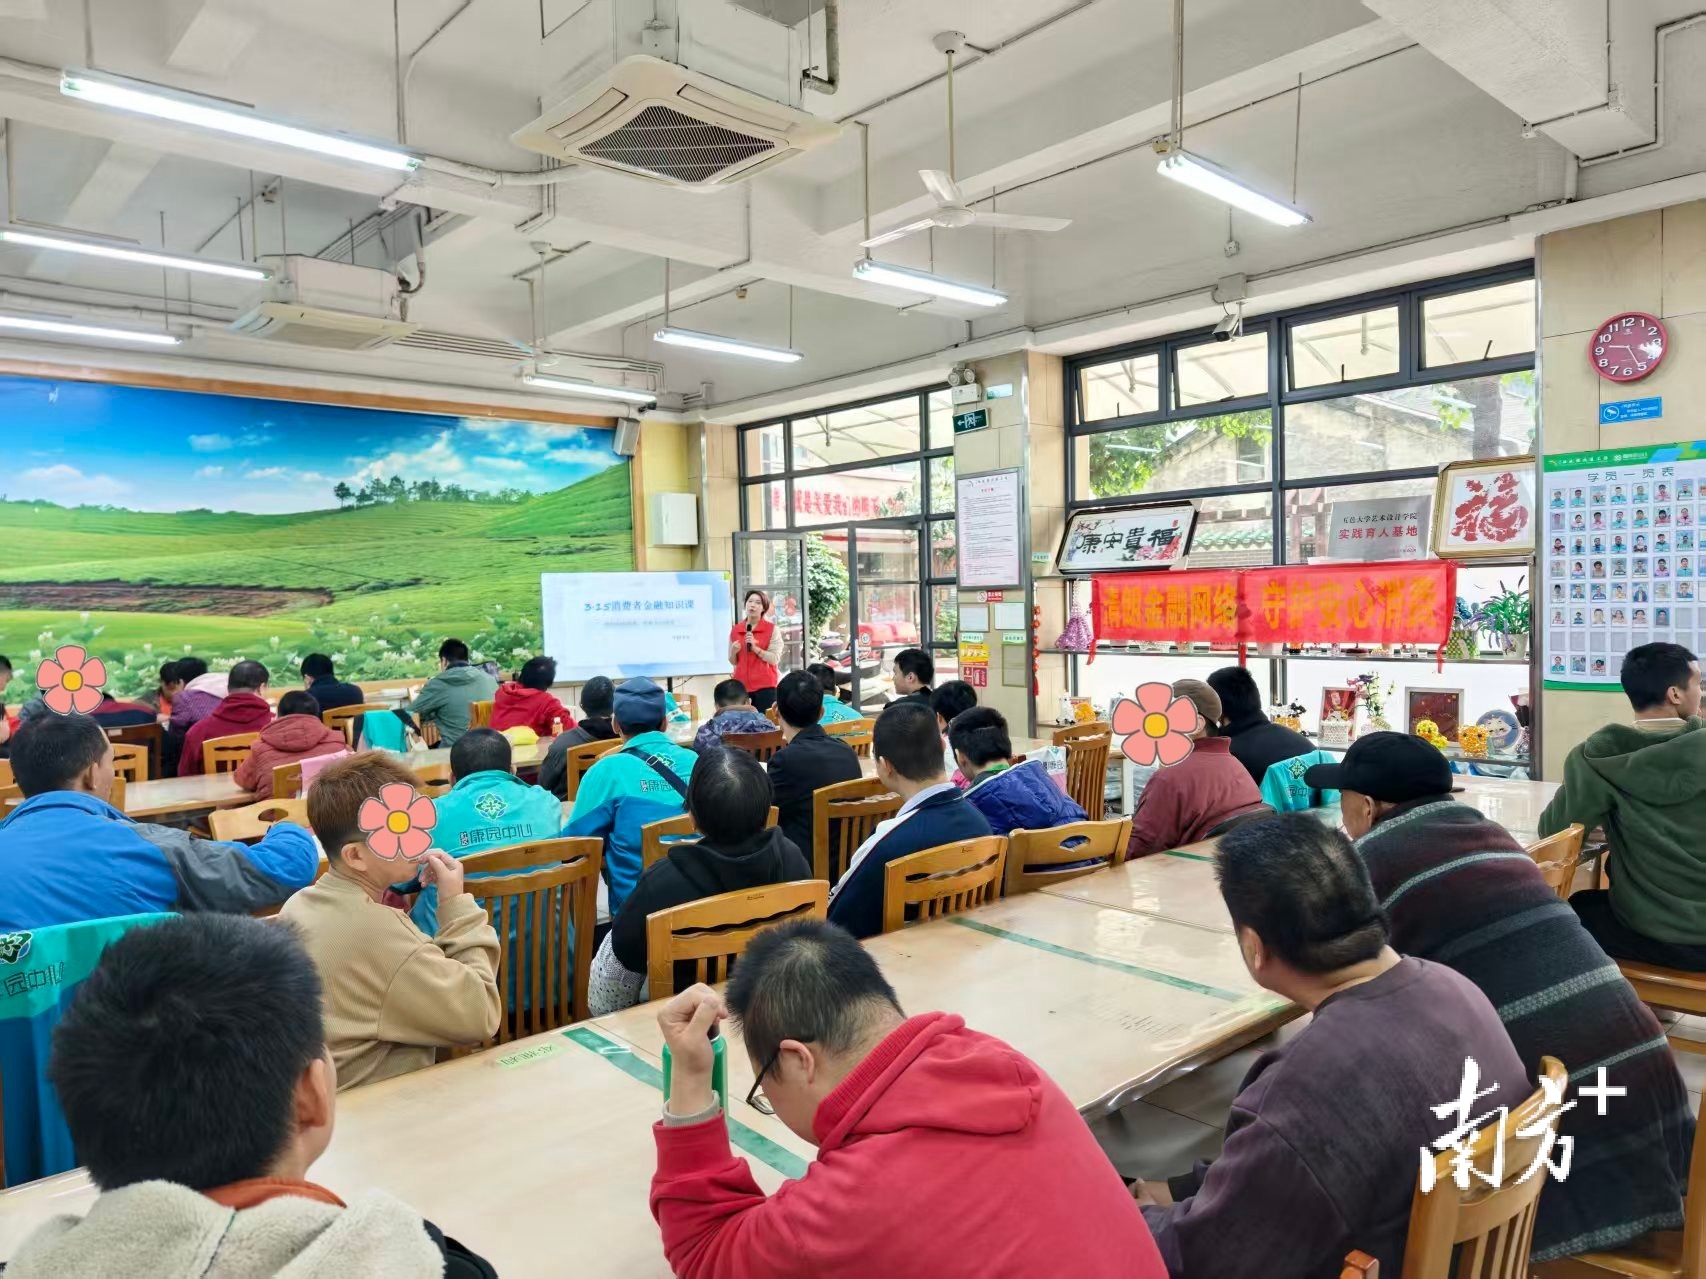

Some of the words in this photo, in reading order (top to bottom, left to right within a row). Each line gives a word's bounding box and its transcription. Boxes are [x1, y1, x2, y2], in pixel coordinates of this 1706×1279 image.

[1621, 317, 1635, 327] 12
[1640, 319, 1645, 328] 1
[1609, 323, 1619, 333] 11
[1647, 326, 1658, 336] 2
[1599, 334, 1612, 343] 10
[1595, 346, 1605, 356] 9
[1599, 358, 1609, 367] 8
[1637, 362, 1647, 371] 5
[1610, 365, 1620, 375] 7
[1623, 367, 1633, 376] 6
[1587, 466, 1675, 483] 学员一览表
[1338, 524, 1418, 540] 实践育人基地
[0, 961, 65, 997] 园中心
